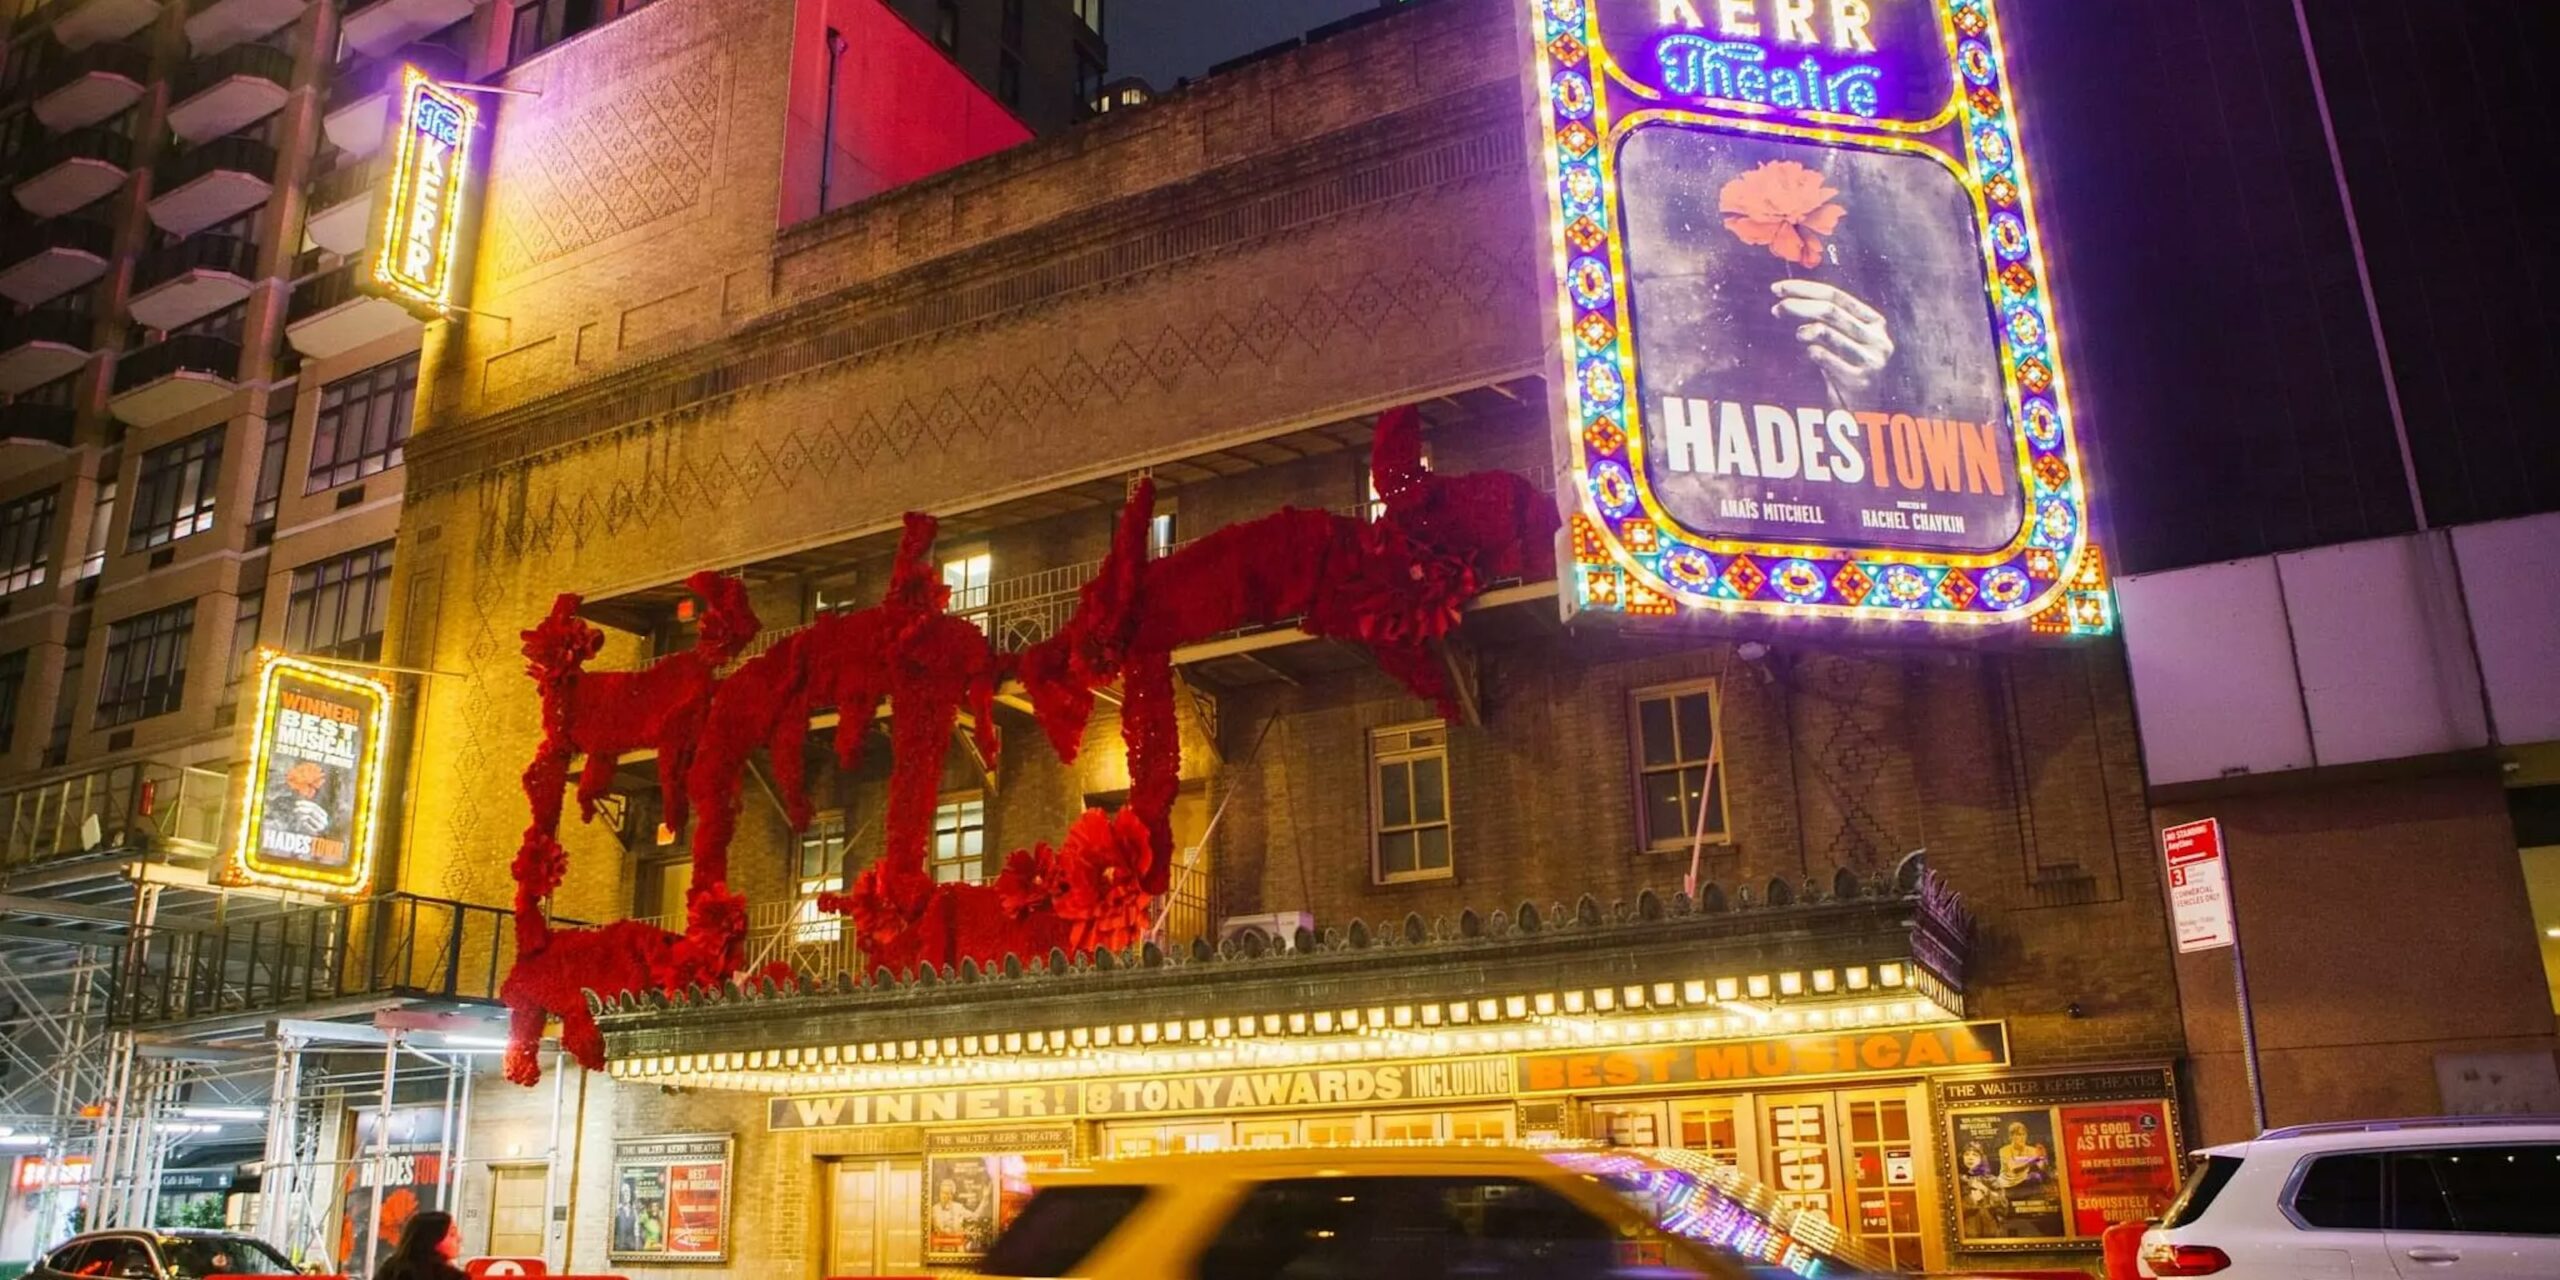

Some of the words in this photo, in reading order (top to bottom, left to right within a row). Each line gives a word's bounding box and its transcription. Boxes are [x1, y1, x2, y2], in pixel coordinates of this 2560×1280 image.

[1657, 34, 1882, 117] Theatre
[418, 100, 457, 144] The
[403, 136, 447, 283] KERR
[1662, 396, 2005, 496] HADESTOWN
[1763, 502, 1825, 524] MITCHELL
[1861, 509, 1910, 529] RACHEL
[1913, 515, 1965, 534] CHAVKIN
[282, 691, 360, 725] WINNER!
[280, 708, 358, 741] BEST
[277, 724, 355, 759] MUSICAL
[2173, 869, 2184, 886] 3
[794, 1086, 1066, 1126] WINNER!
[1086, 1083, 1113, 1113] 8
[1119, 1075, 1225, 1112] TONY
[1410, 1059, 1509, 1098] INCLUDING
[1528, 1051, 1679, 1090] BEST
[1695, 1032, 1993, 1079] MUSICAL
[1947, 1085, 1976, 1097] THE
[1981, 1081, 2039, 1096] WALTER
[2044, 1079, 2085, 1094] KERR
[2091, 1073, 2163, 1090] THEATRE
[936, 1135, 951, 1145] THE
[956, 1133, 990, 1144] WALTER
[1022, 1131, 1062, 1142] THEATRE
[2077, 1136, 2096, 1151] AS
[2098, 1135, 2111, 1149] IT
[2083, 1124, 2098, 1135] AS
[2100, 1122, 2131, 1134] GOOD
[2077, 1195, 2149, 1210] EXQUISITELY
